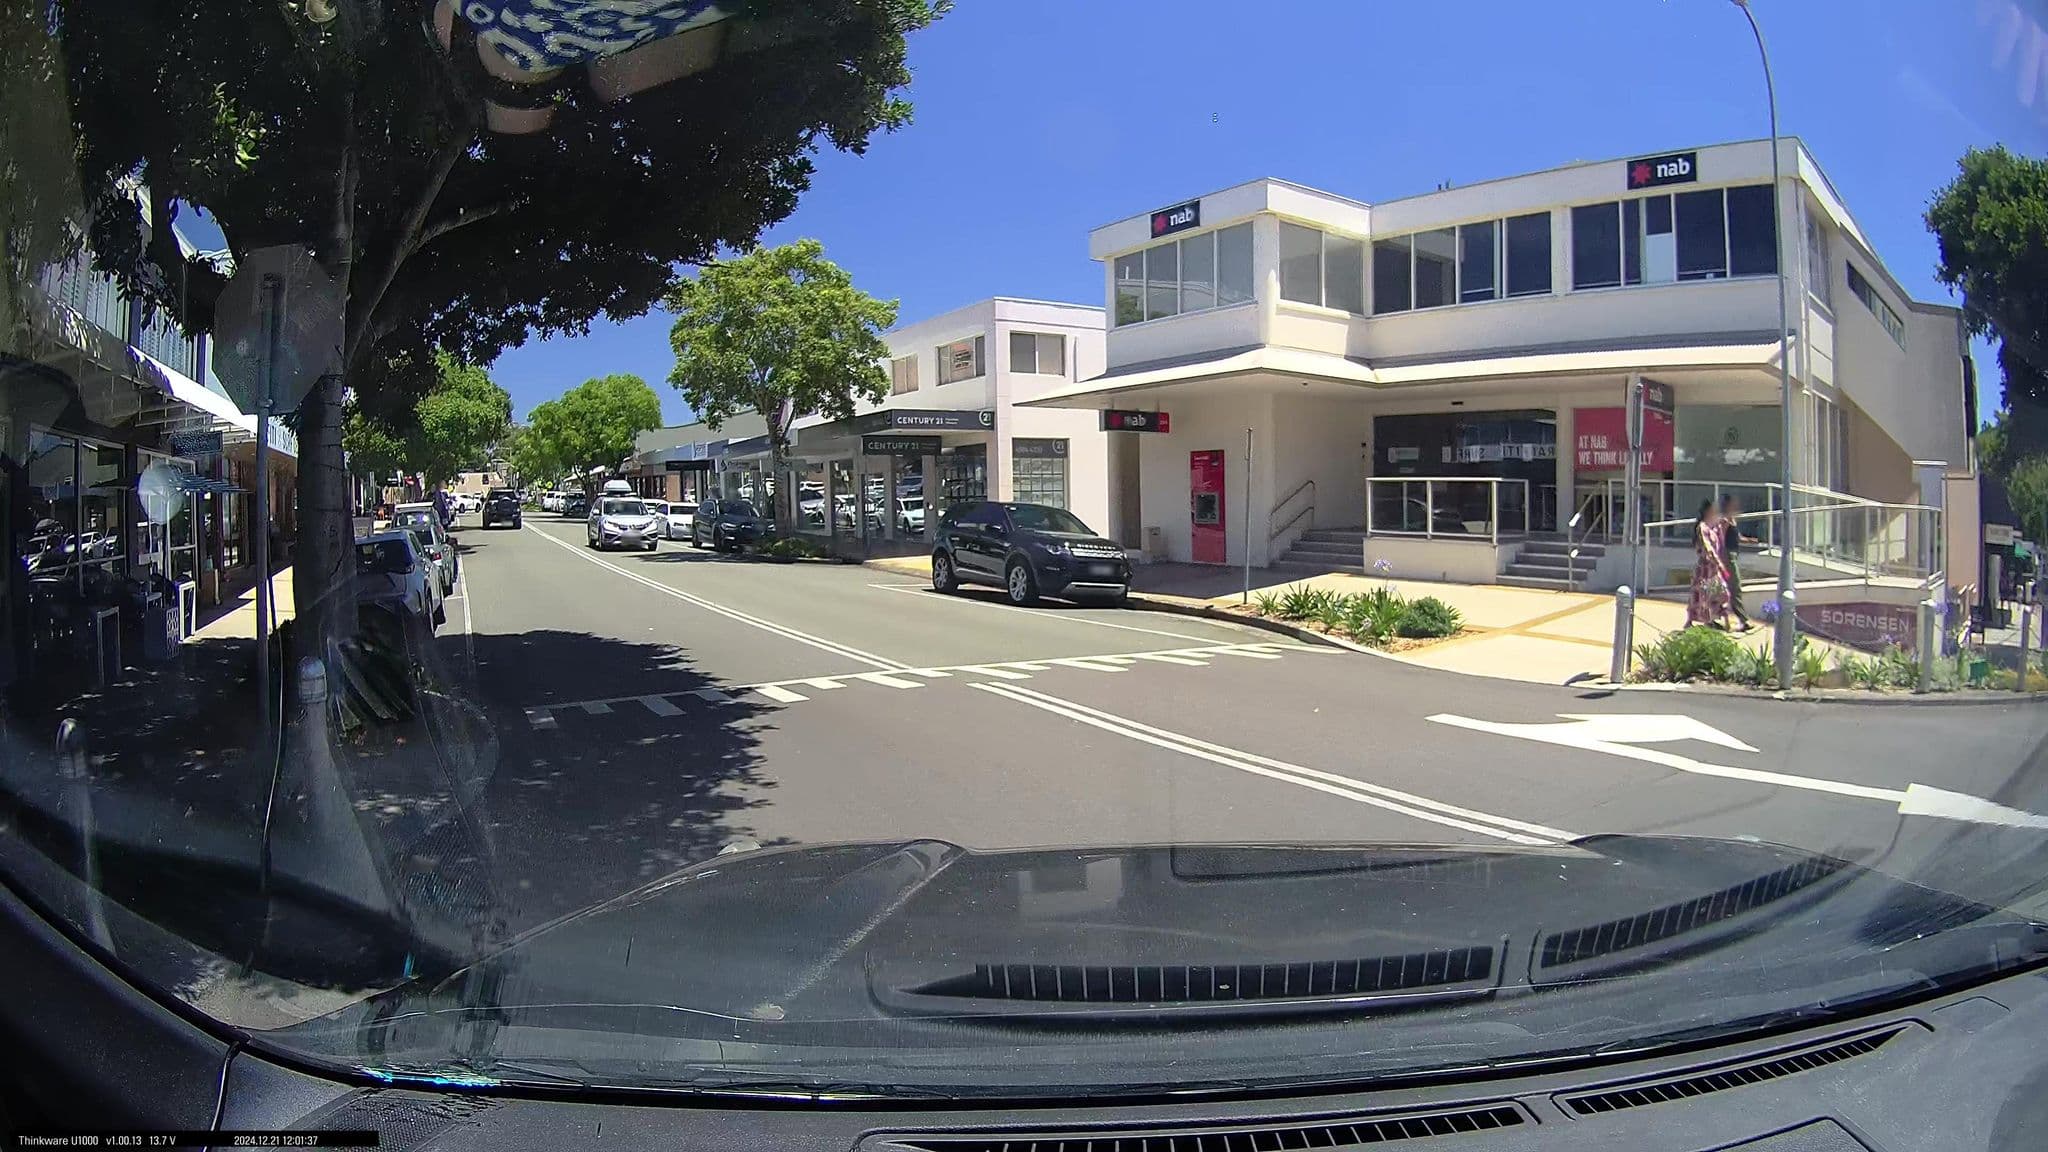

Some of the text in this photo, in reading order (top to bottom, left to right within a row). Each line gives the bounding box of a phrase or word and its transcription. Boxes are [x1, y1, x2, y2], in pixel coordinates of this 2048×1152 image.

[1656, 158, 1691, 178] nab
[1170, 208, 1194, 226] nab
[897, 416, 934, 425] CENTURY
[935, 416, 943, 425] 21
[868, 441, 909, 450] CENTURY
[1578, 435, 1607, 449] AT NAB
[1578, 451, 1591, 465] WE
[1594, 451, 1617, 465] THINK
[1821, 610, 1909, 632] SORENSEN
